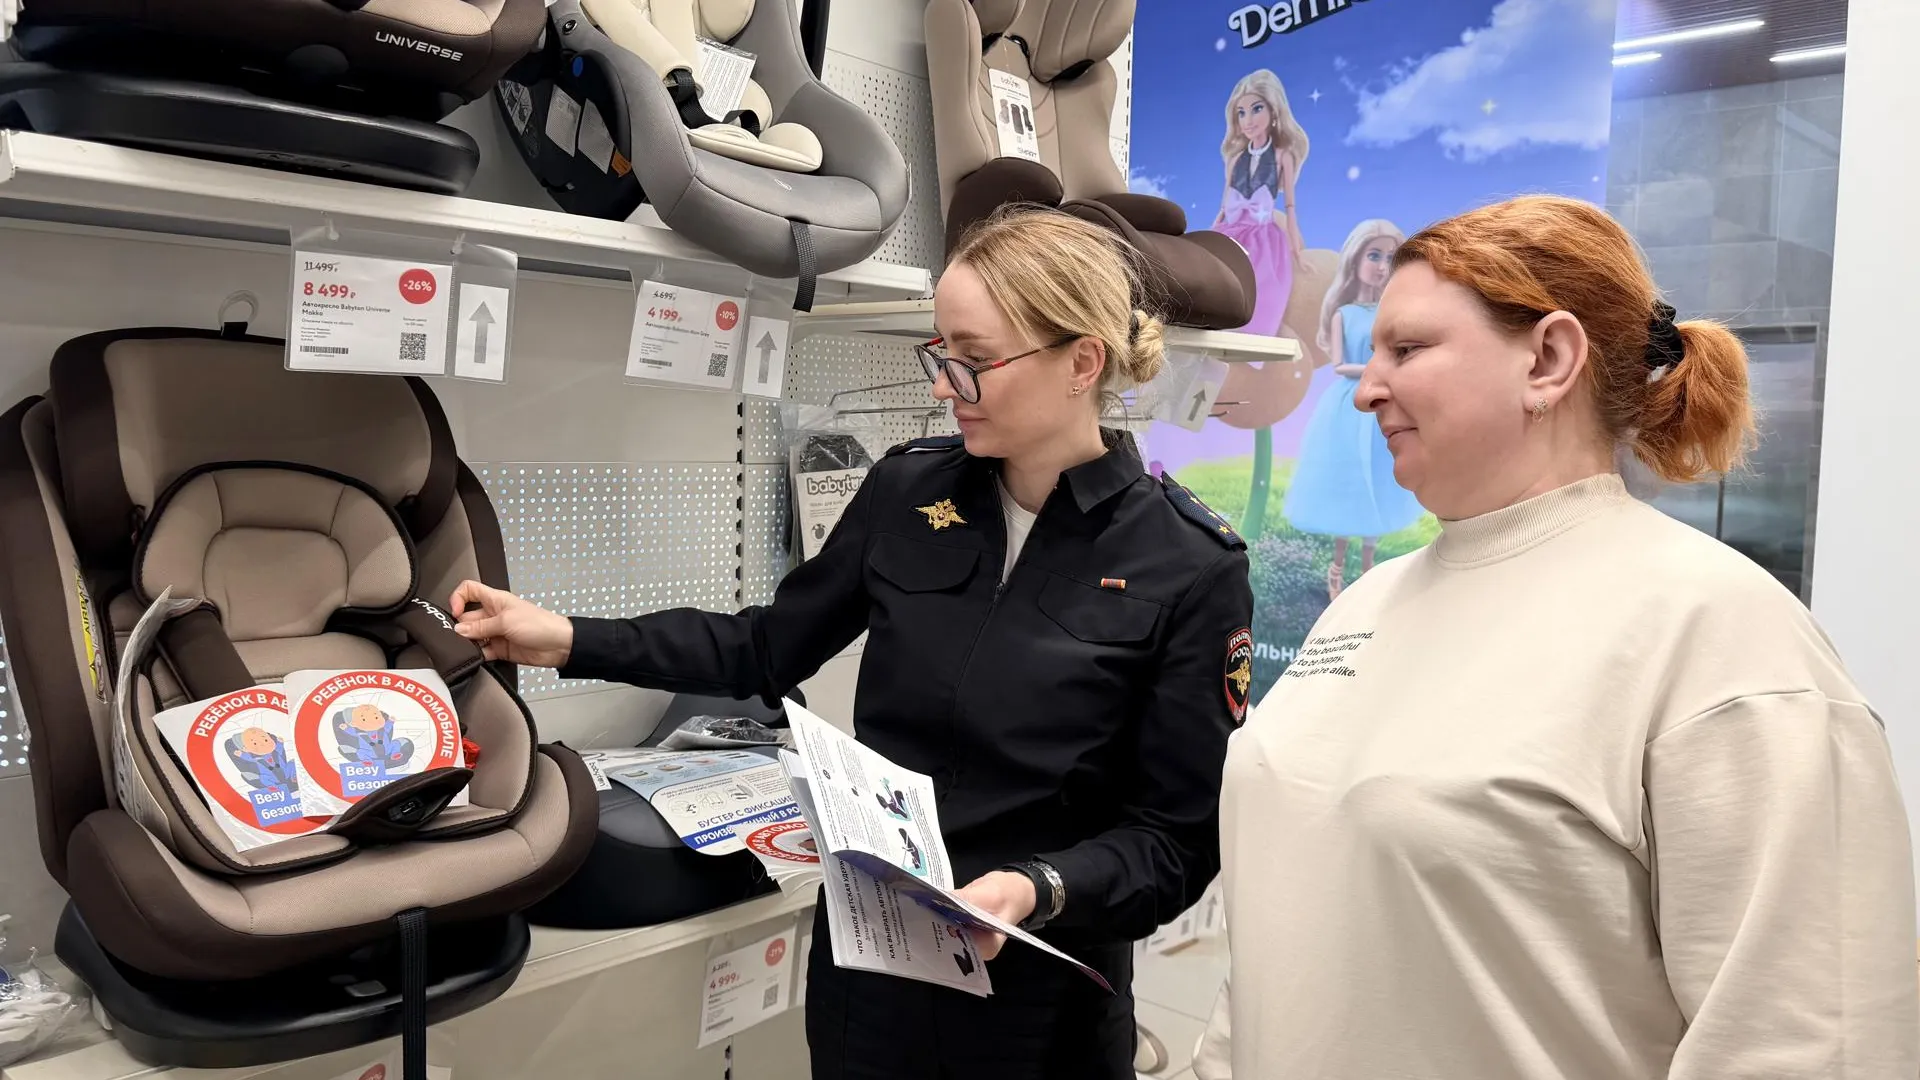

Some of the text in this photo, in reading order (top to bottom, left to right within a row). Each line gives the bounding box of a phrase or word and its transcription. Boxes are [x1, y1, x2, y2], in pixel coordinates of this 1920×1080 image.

[375, 31, 463, 62] UNIVERSE
[304, 281, 313, 295] 8
[403, 280, 432, 292] -26%
[1329, 666, 1357, 677] alike.
[195, 694, 254, 738] РЕБЁНОК
[256, 693, 268, 704] В
[312, 674, 455, 759] РЕБЁНОК В АВТОМОБИЛЕ
[346, 766, 379, 777] Везу
[254, 790, 286, 805] Везу
[698, 812, 735, 830] БУСТЕР
[736, 808, 745, 818] С
[851, 914, 861, 938] ТАКОЕ
